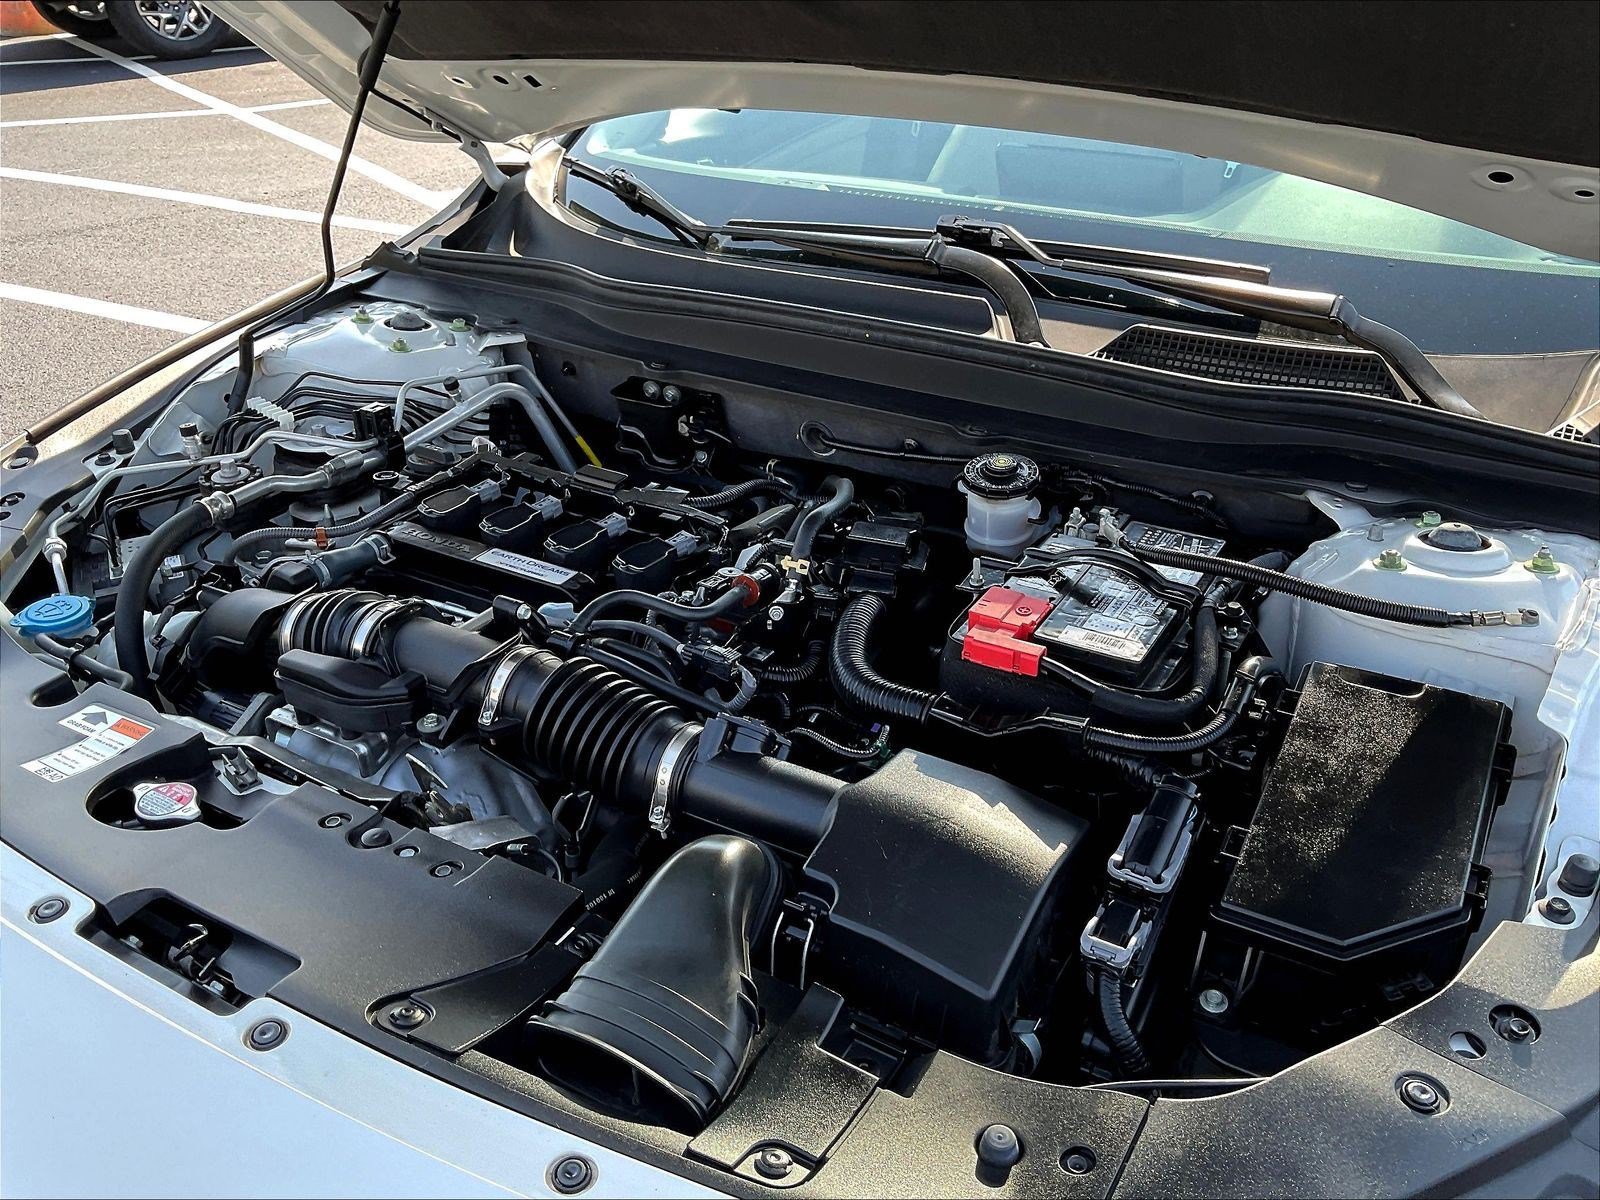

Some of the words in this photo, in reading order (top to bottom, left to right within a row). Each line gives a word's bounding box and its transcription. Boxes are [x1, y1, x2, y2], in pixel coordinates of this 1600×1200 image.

[402, 528, 470, 553] HONDA
[491, 551, 526, 563] EARTH
[526, 560, 571, 577] DREAMS
